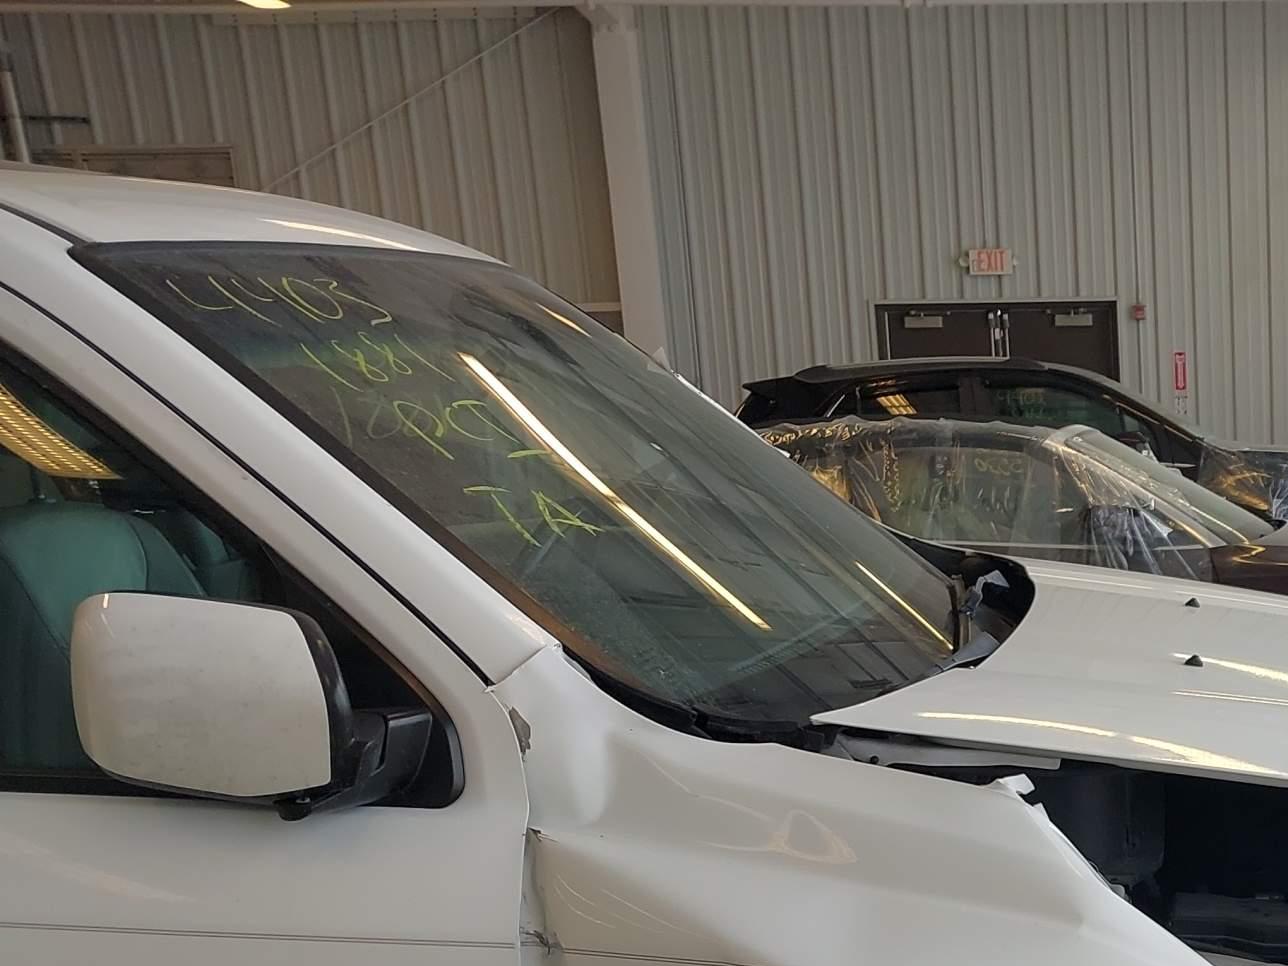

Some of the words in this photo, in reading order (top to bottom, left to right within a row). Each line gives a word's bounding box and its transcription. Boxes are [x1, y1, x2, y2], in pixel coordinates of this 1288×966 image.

[976, 250, 1006, 272] EXIT
[165, 275, 393, 327] 4403
[299, 331, 457, 393] 1881
